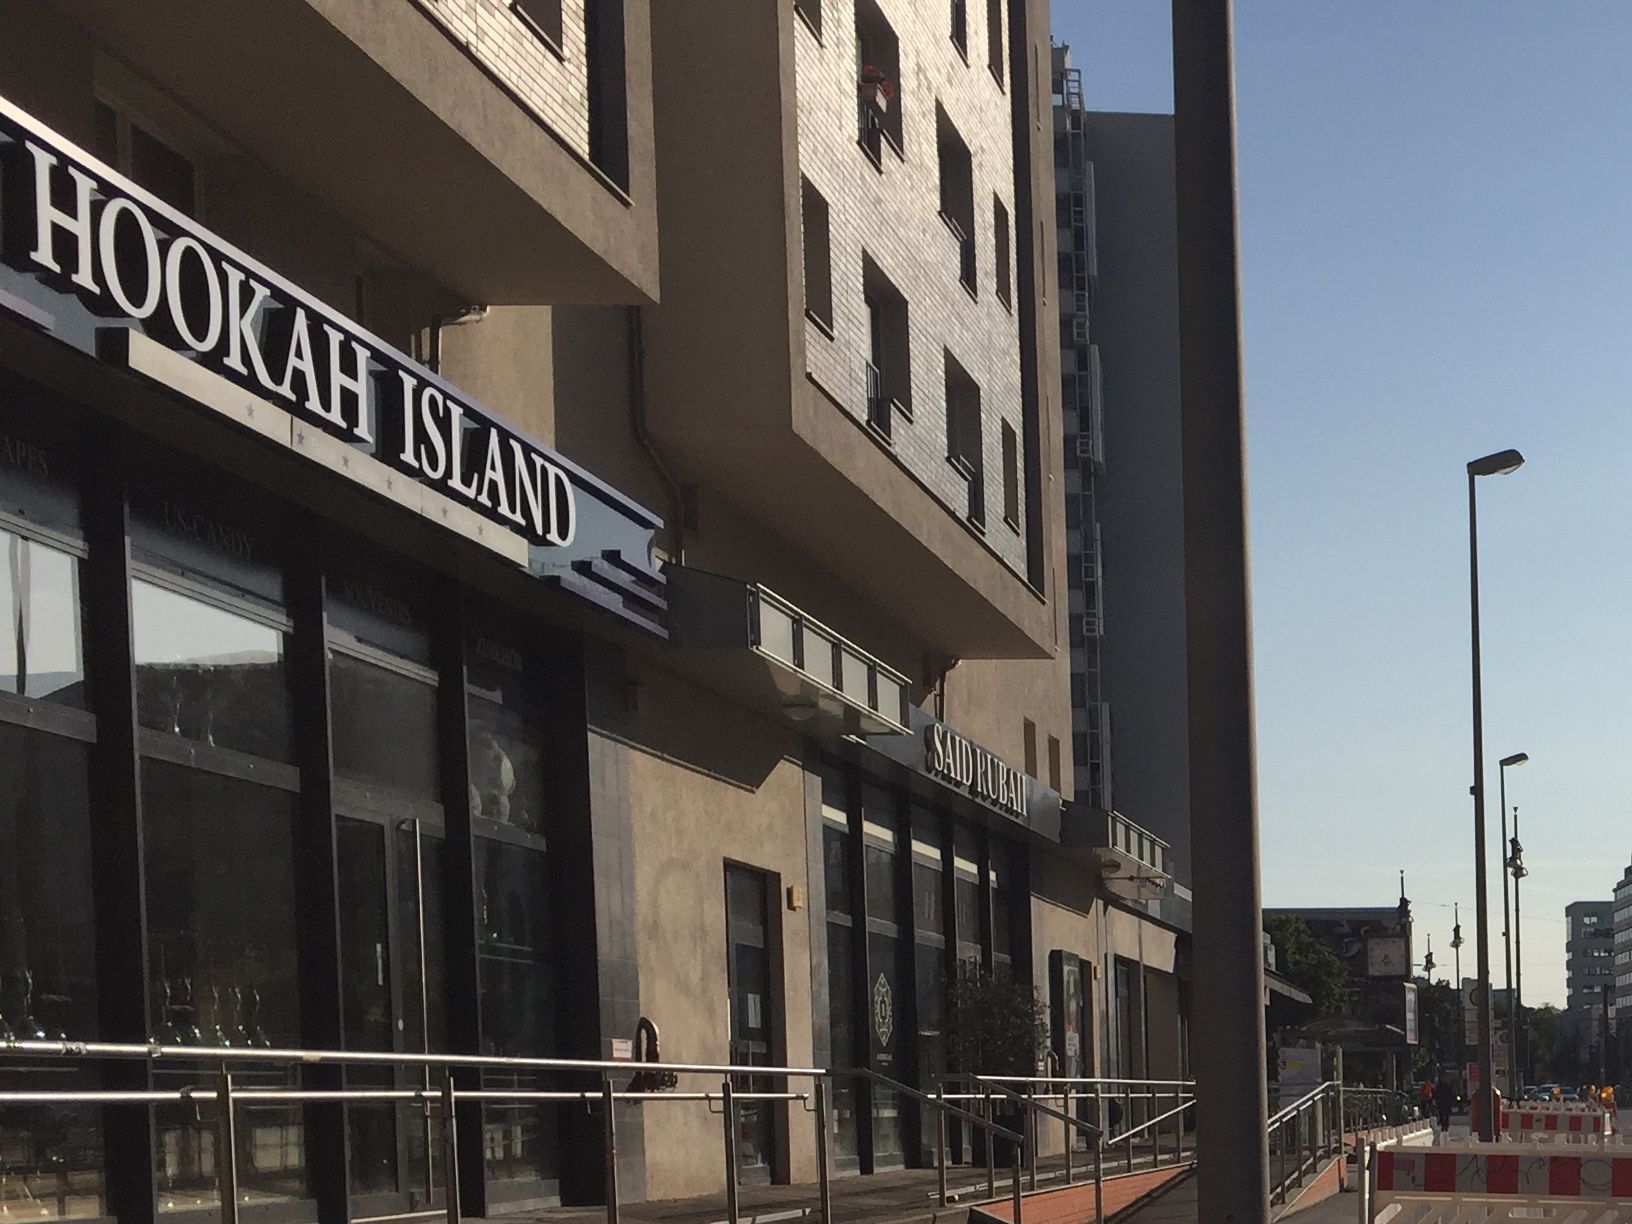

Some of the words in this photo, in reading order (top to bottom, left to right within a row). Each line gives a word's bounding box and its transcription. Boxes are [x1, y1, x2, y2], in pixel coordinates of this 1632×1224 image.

[25, 140, 374, 444] HOOKAH
[398, 368, 577, 547] ISLAND
[934, 722, 973, 786] SAID
[976, 748, 1027, 817] RUBAII
